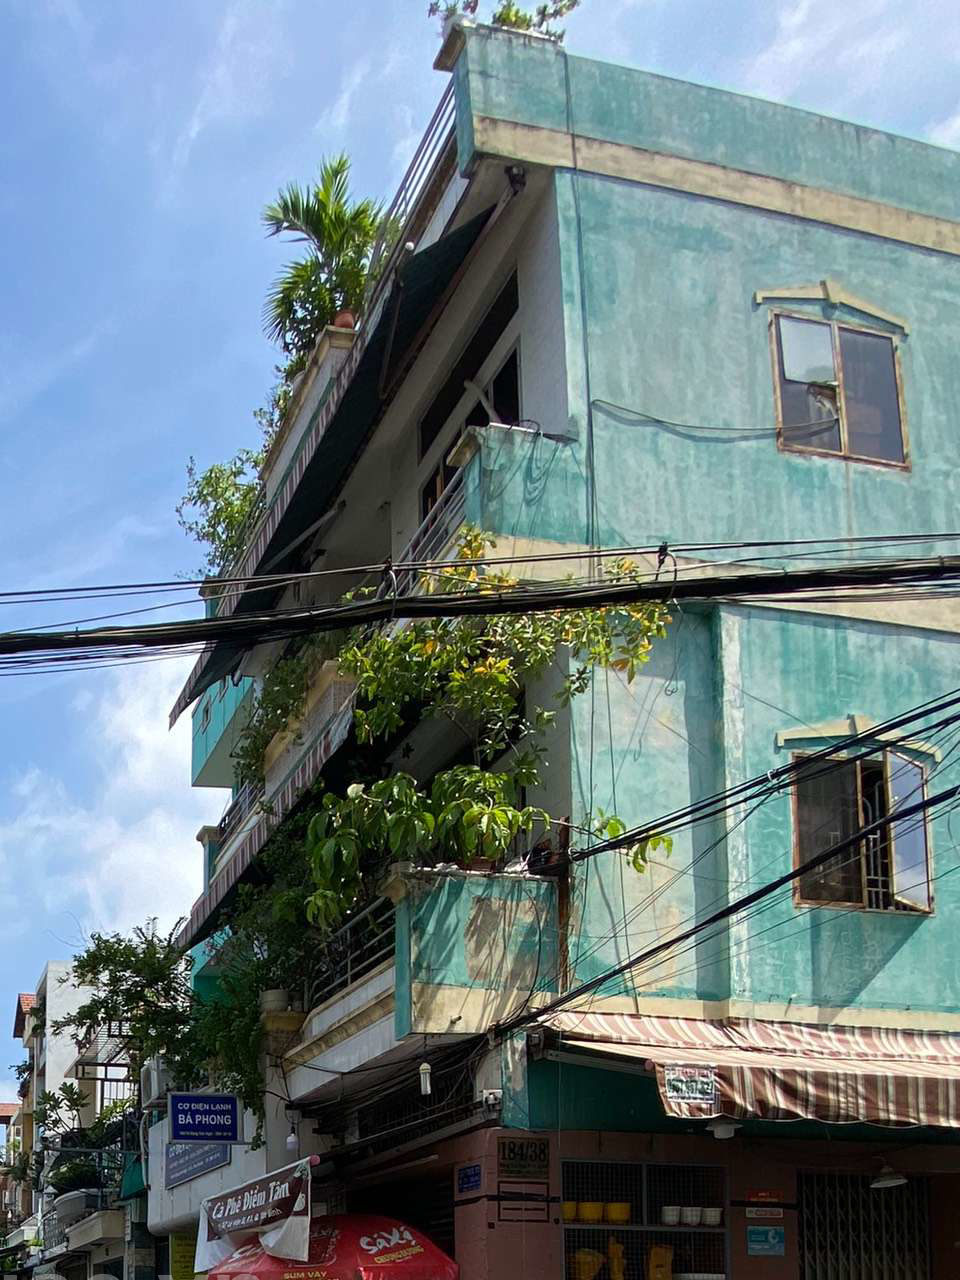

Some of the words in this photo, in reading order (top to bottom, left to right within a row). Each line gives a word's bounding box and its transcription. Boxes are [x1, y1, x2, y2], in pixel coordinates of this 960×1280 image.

[195, 1114, 232, 1125] PHONG
[500, 1140, 546, 1162] 184/38
[268, 1180, 290, 1203] Tâm
